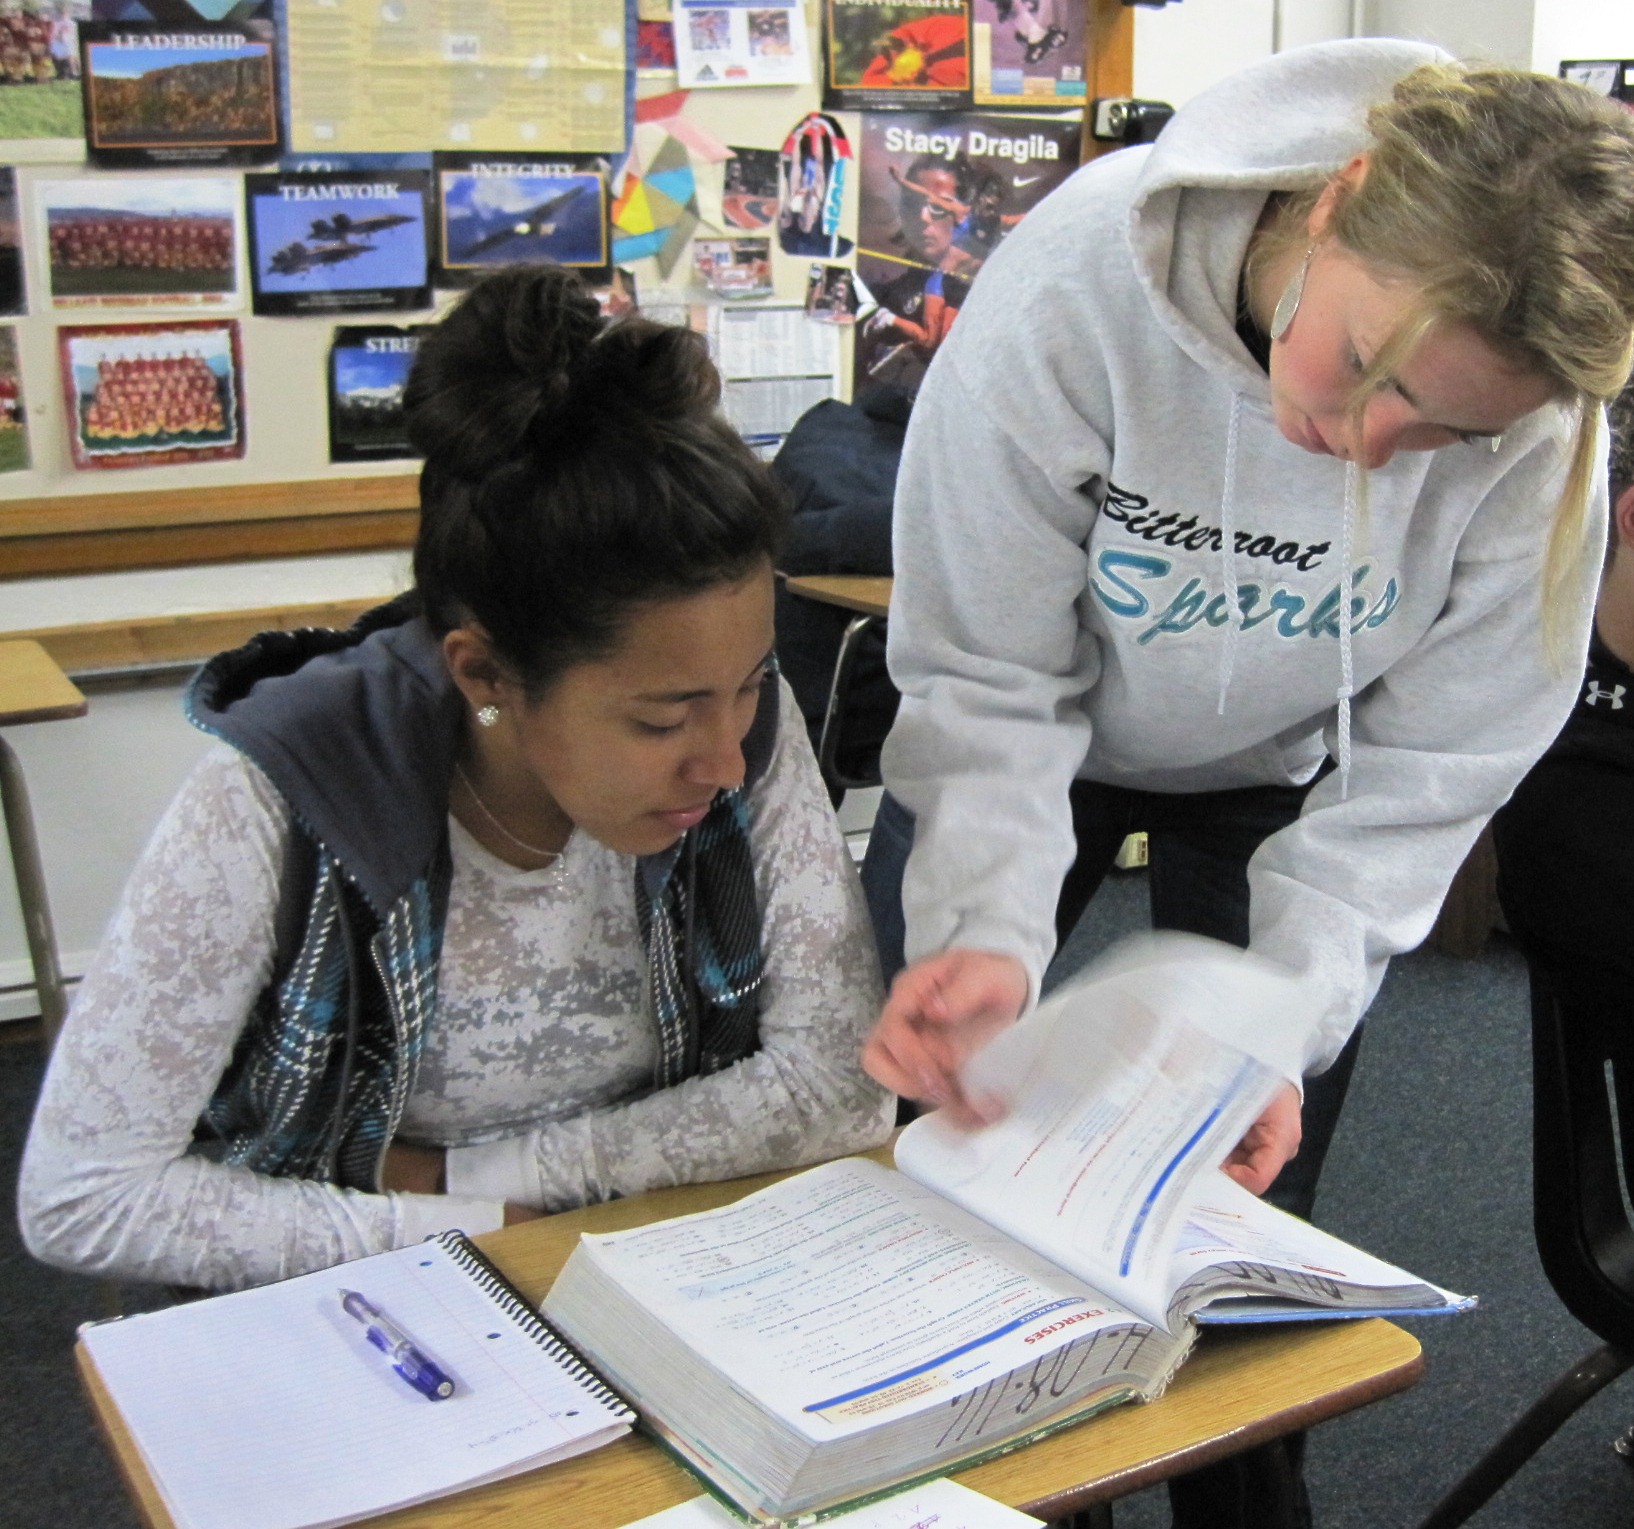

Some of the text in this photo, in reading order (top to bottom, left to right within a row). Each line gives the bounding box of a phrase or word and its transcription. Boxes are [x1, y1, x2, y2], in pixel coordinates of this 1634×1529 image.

[112, 33, 246, 51] LEADERSHIP
[885, 126, 1059, 164] Stacy Dragila
[471, 162, 577, 179] INTEGRITY
[279, 183, 400, 202] TEAMWORK
[366, 336, 420, 353] STRE
[1103, 482, 1332, 571] Bitterroot
[1090, 550, 1398, 646] Sparks
[1018, 1303, 1061, 1323] PRACTICE
[1024, 1308, 1105, 1345] EXERCISES
